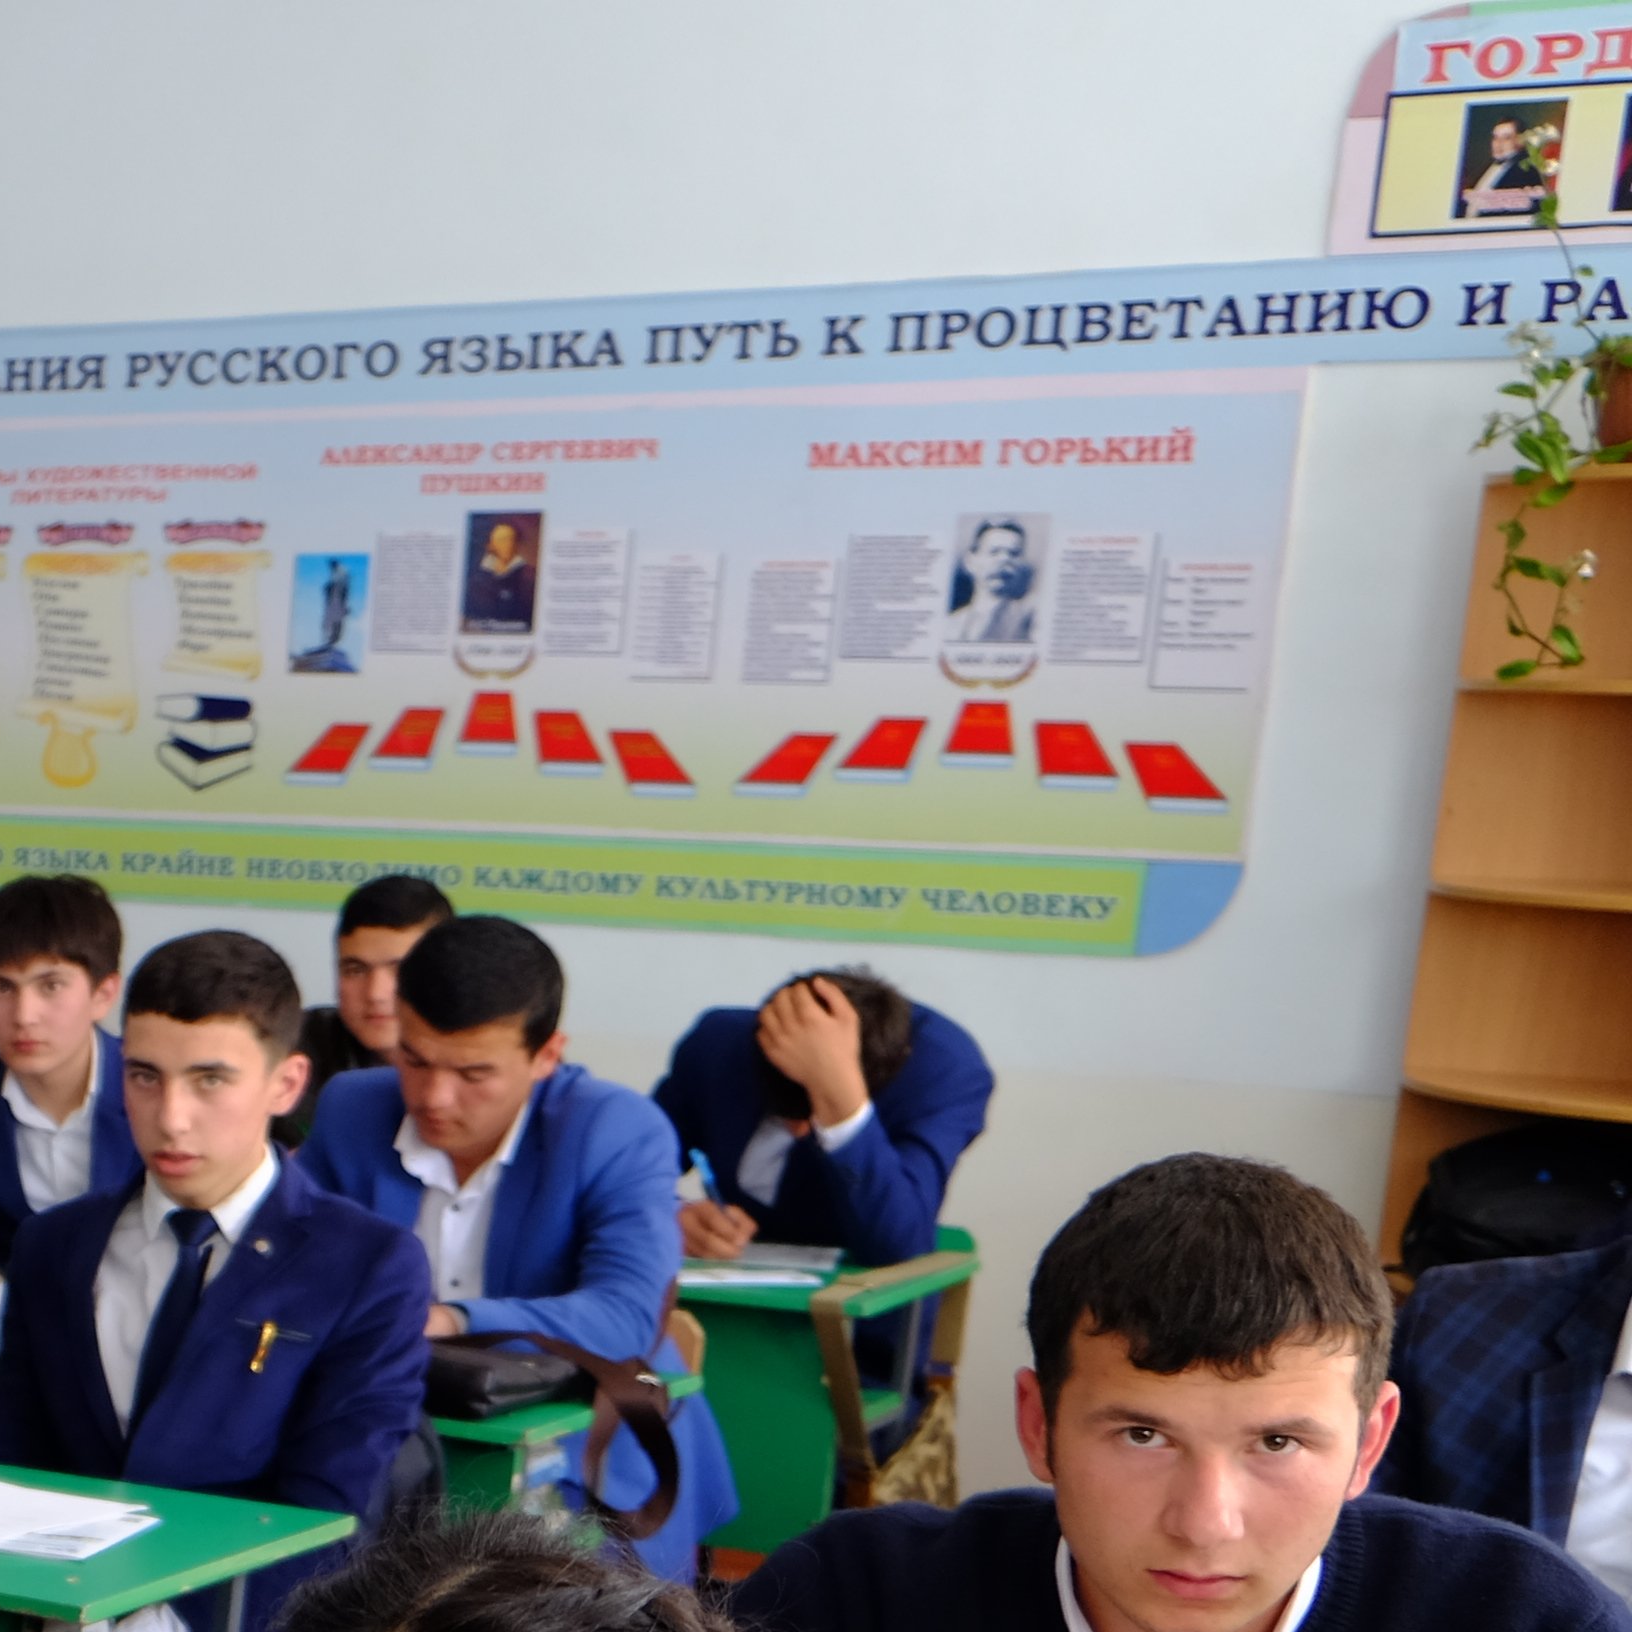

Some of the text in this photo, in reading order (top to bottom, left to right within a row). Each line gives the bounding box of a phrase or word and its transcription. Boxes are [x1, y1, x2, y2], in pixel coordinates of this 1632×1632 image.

[125, 340, 401, 389] РУССКОГО
[418, 329, 624, 376] ЯЗЫКА
[644, 319, 801, 365] ПУТЬ
[821, 315, 863, 356] К
[888, 286, 1431, 353] ПРОЦВЕТАНИЮ
[1458, 283, 1511, 327] И
[1536, 275, 1631, 326] РА
[319, 438, 659, 467] АЛЕКСАНДР СЕРГЕЕВИЧ
[808, 427, 1196, 469] МАКСИМ ГОРЬКИЙ
[25, 463, 259, 486] ХУДОЖЕСТВЕННОЙ
[420, 471, 546, 495] ПУШКИН
[10, 485, 167, 505] ЛИТЕРАТУРЫ
[13, 847, 110, 874] ЯЗЫКА
[120, 849, 235, 878] КРАЙНЕ
[473, 866, 642, 895] КАЖДОМУ
[654, 875, 908, 910] КУЛЬТУРНОМУ
[921, 888, 1117, 920] ЧЕЛОВЕКУ
